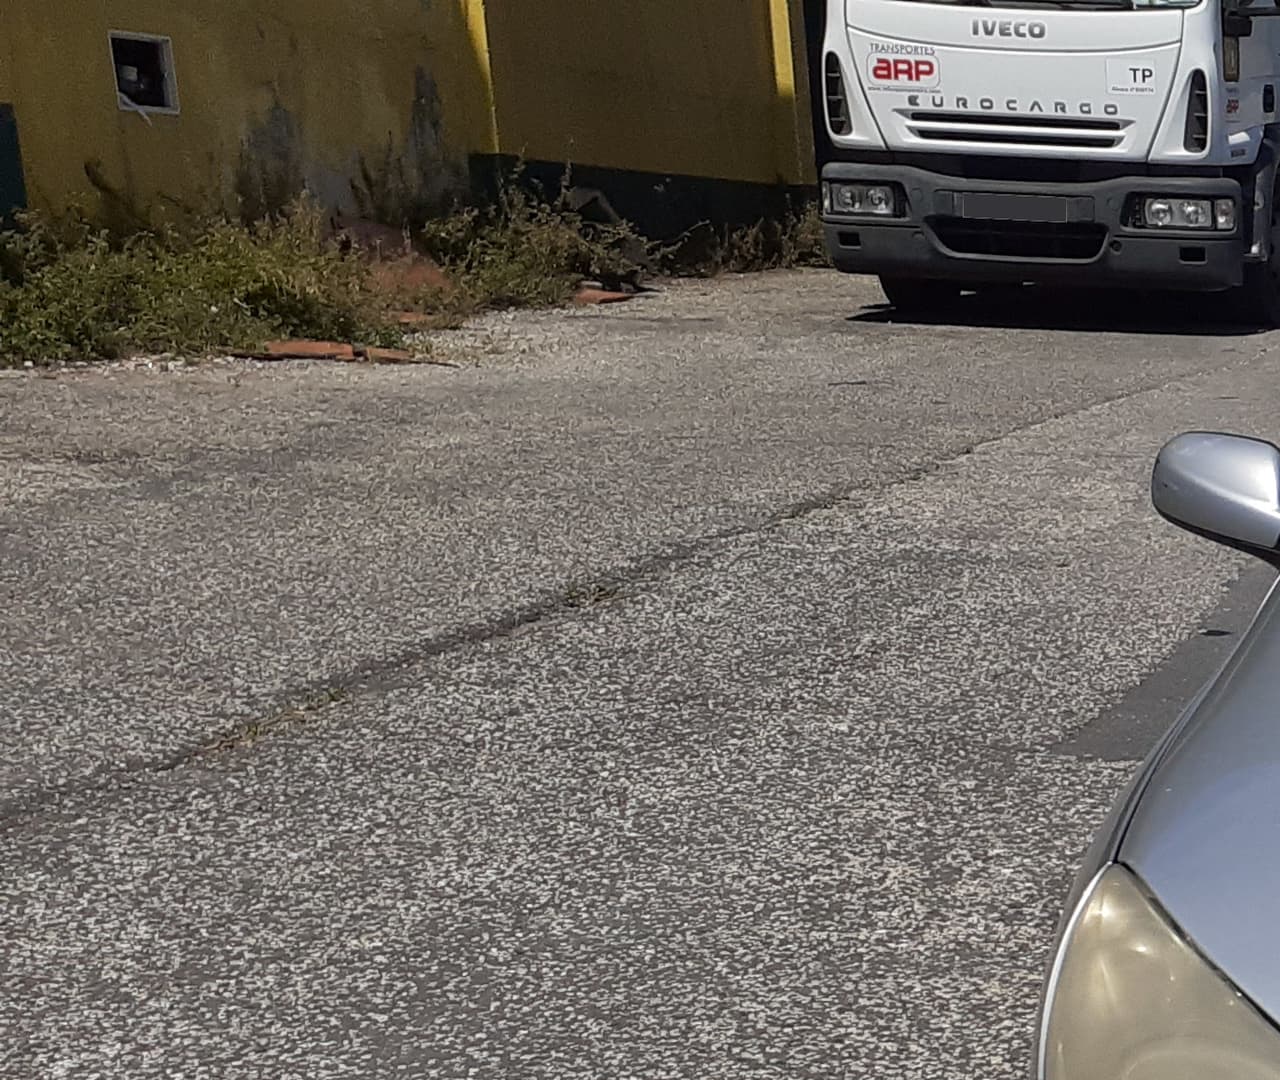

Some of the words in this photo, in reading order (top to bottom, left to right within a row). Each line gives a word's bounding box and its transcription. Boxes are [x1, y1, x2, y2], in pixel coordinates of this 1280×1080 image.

[971, 19, 1046, 39] IVECO
[870, 43, 935, 56] TRANSPORTES
[1129, 68, 1153, 83] TP
[907, 94, 1119, 115] EUROCARGO
